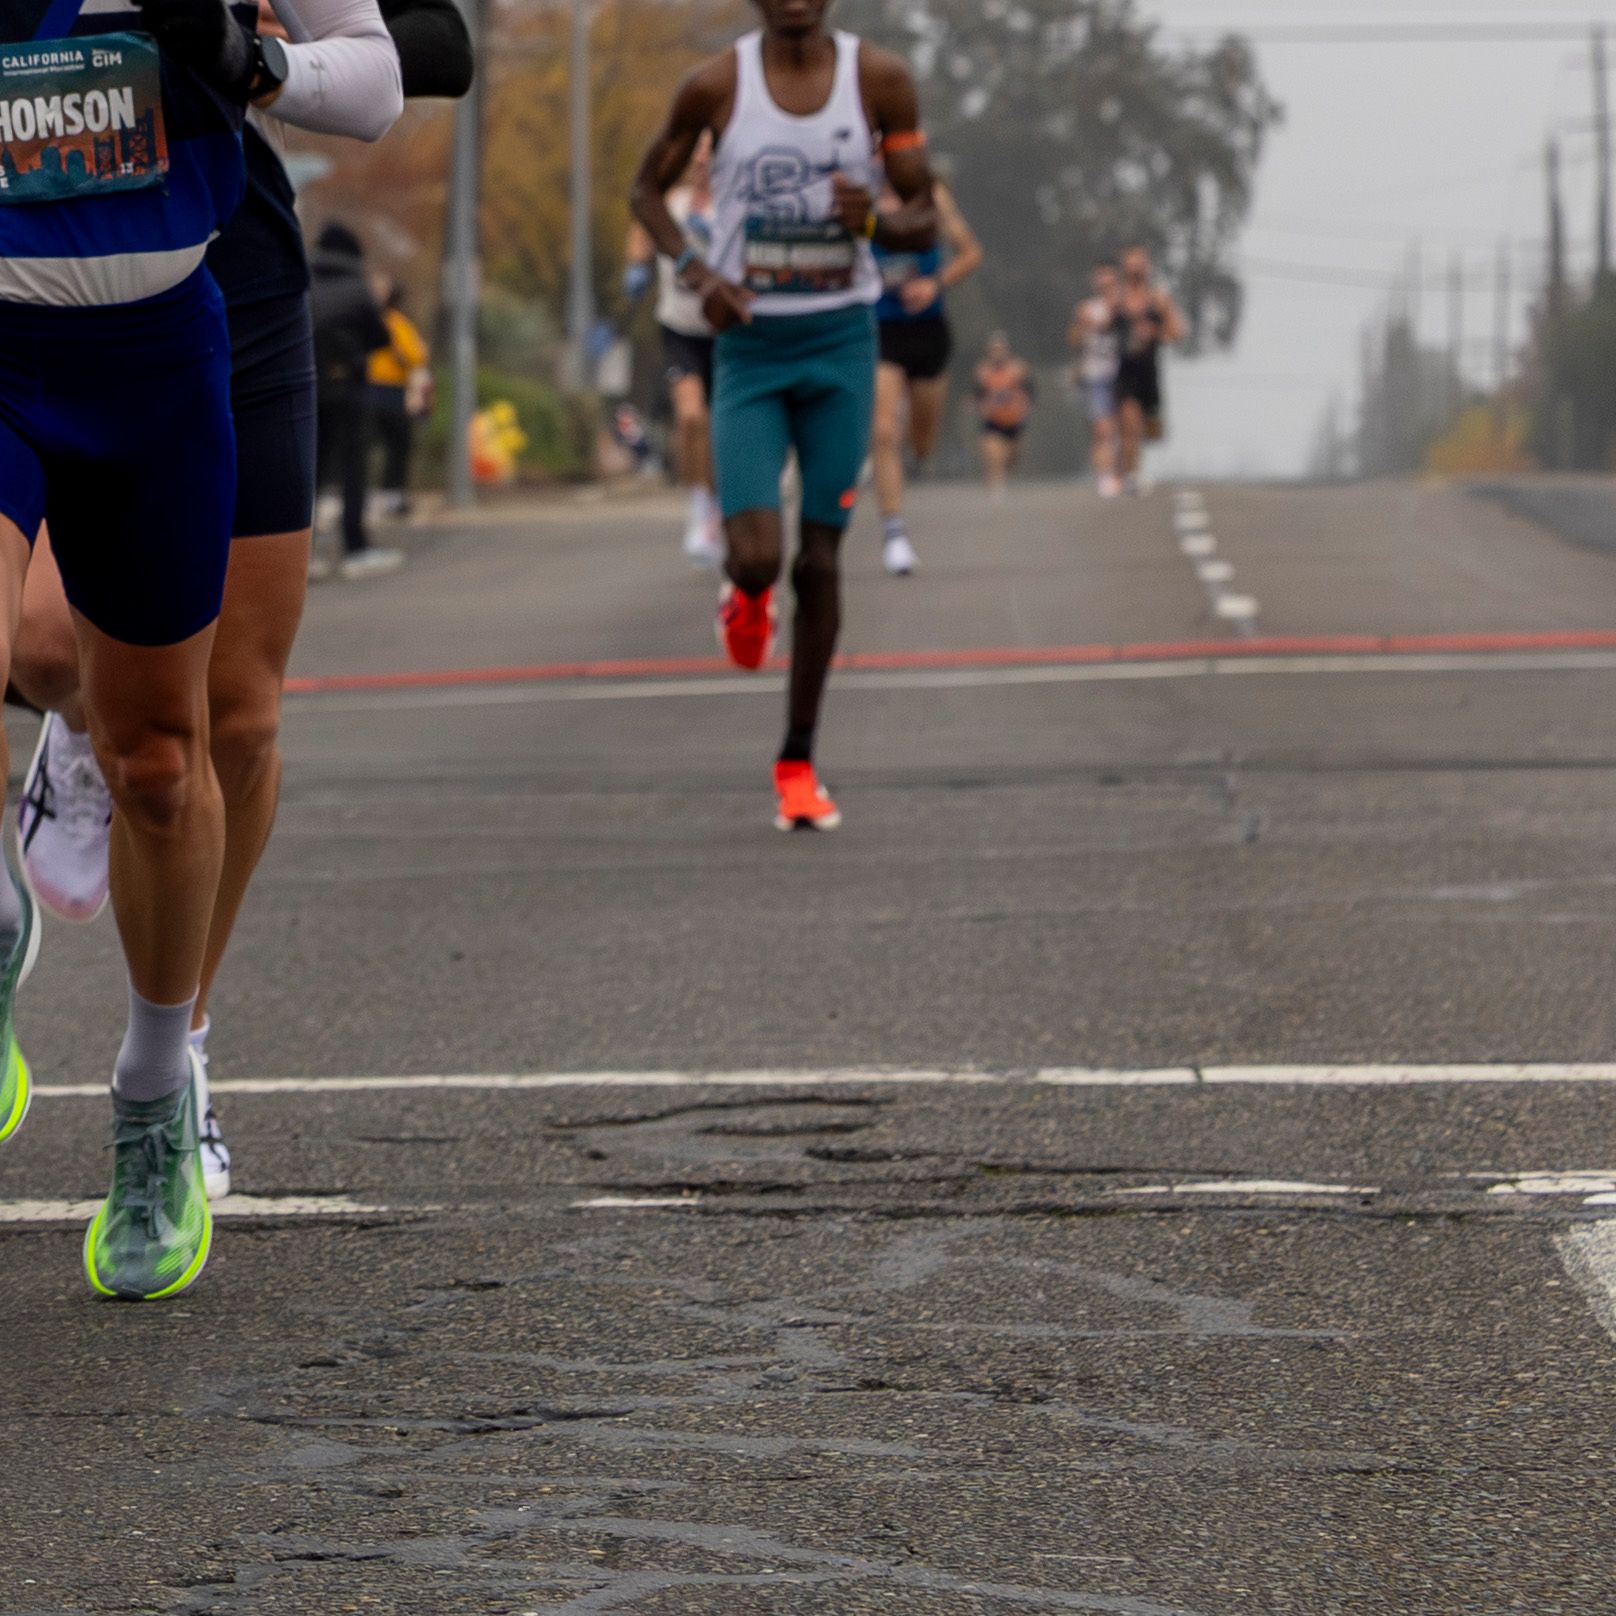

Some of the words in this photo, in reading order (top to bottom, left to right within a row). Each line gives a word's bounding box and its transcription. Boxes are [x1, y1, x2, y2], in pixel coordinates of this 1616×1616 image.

[1, 49, 85, 68] CALIFORNIA
[92, 51, 122, 67] CIM
[120, 162, 134, 175] 13
